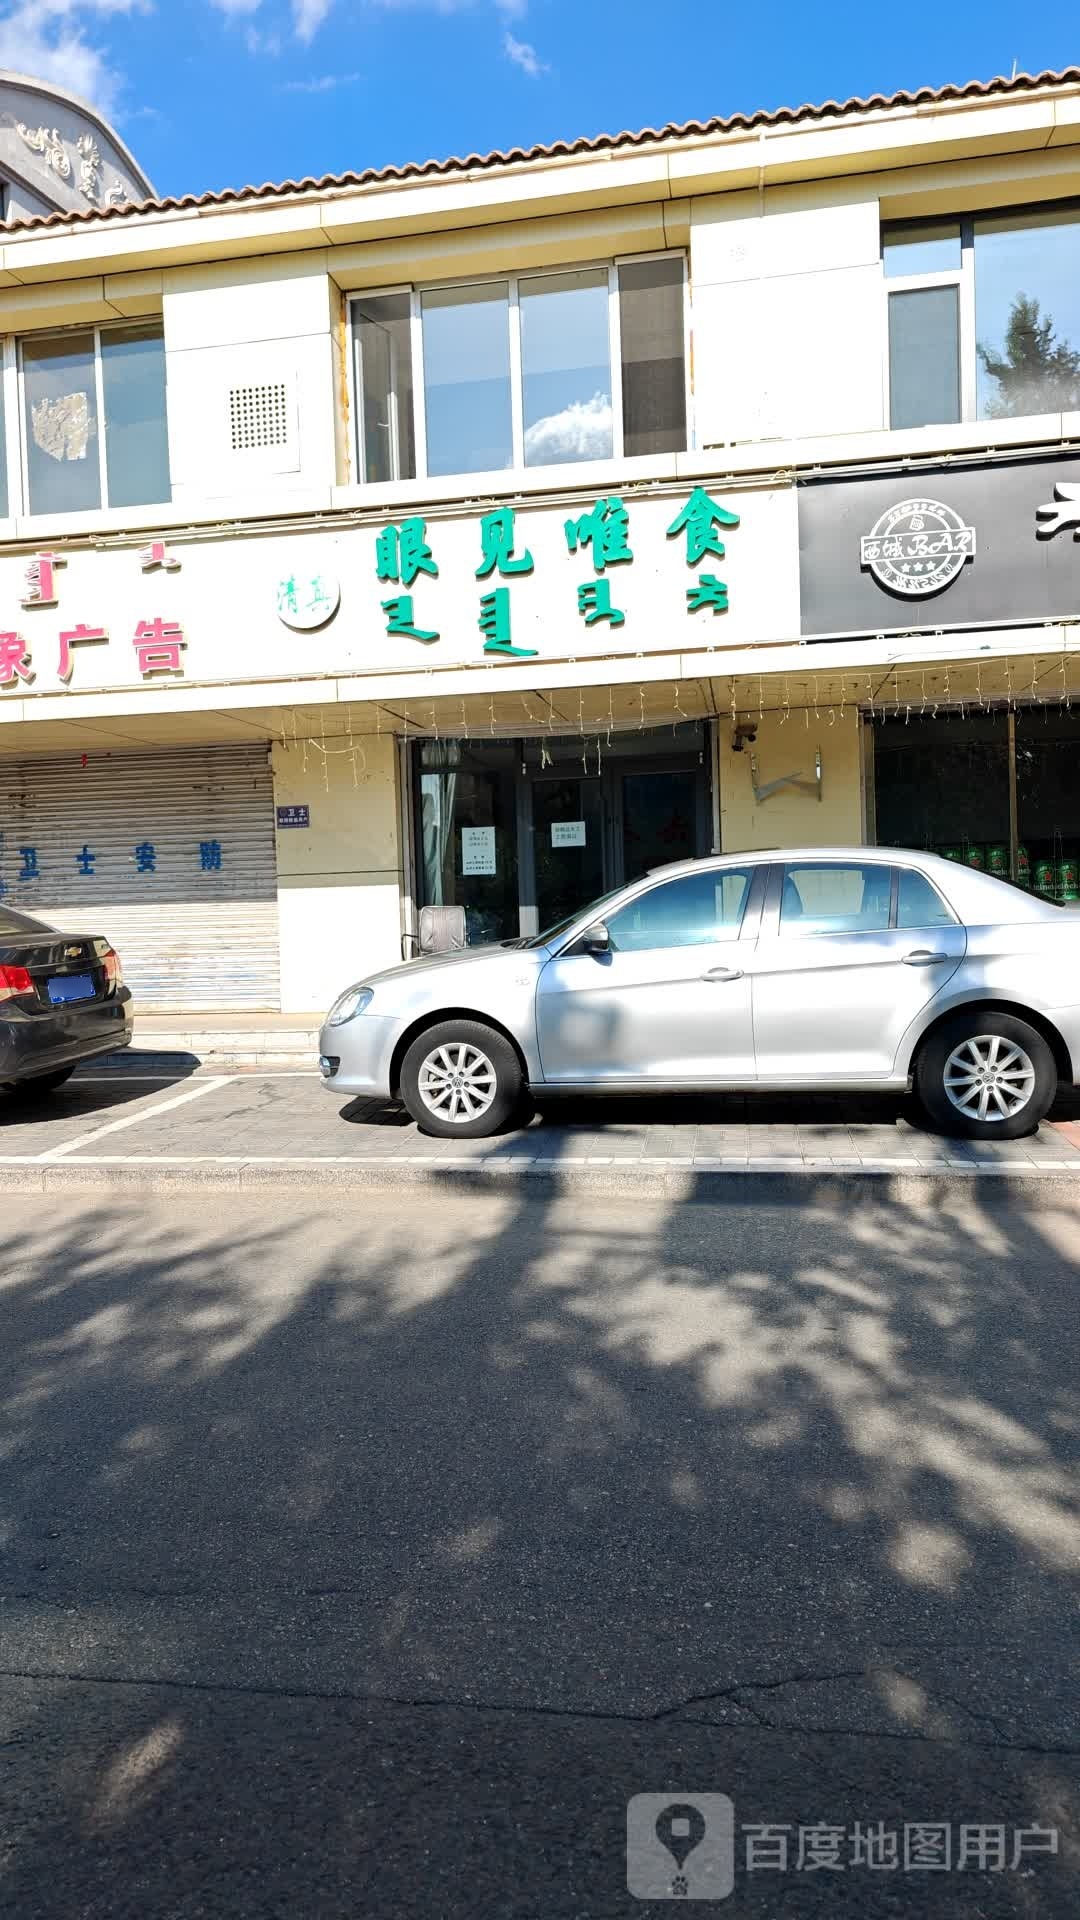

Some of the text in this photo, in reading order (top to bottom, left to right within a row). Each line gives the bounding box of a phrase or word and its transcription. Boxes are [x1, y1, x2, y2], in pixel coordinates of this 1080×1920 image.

[376, 486, 740, 584] 眼见唯食
[907, 531, 972, 556] BAR
[277, 573, 333, 614] 清真
